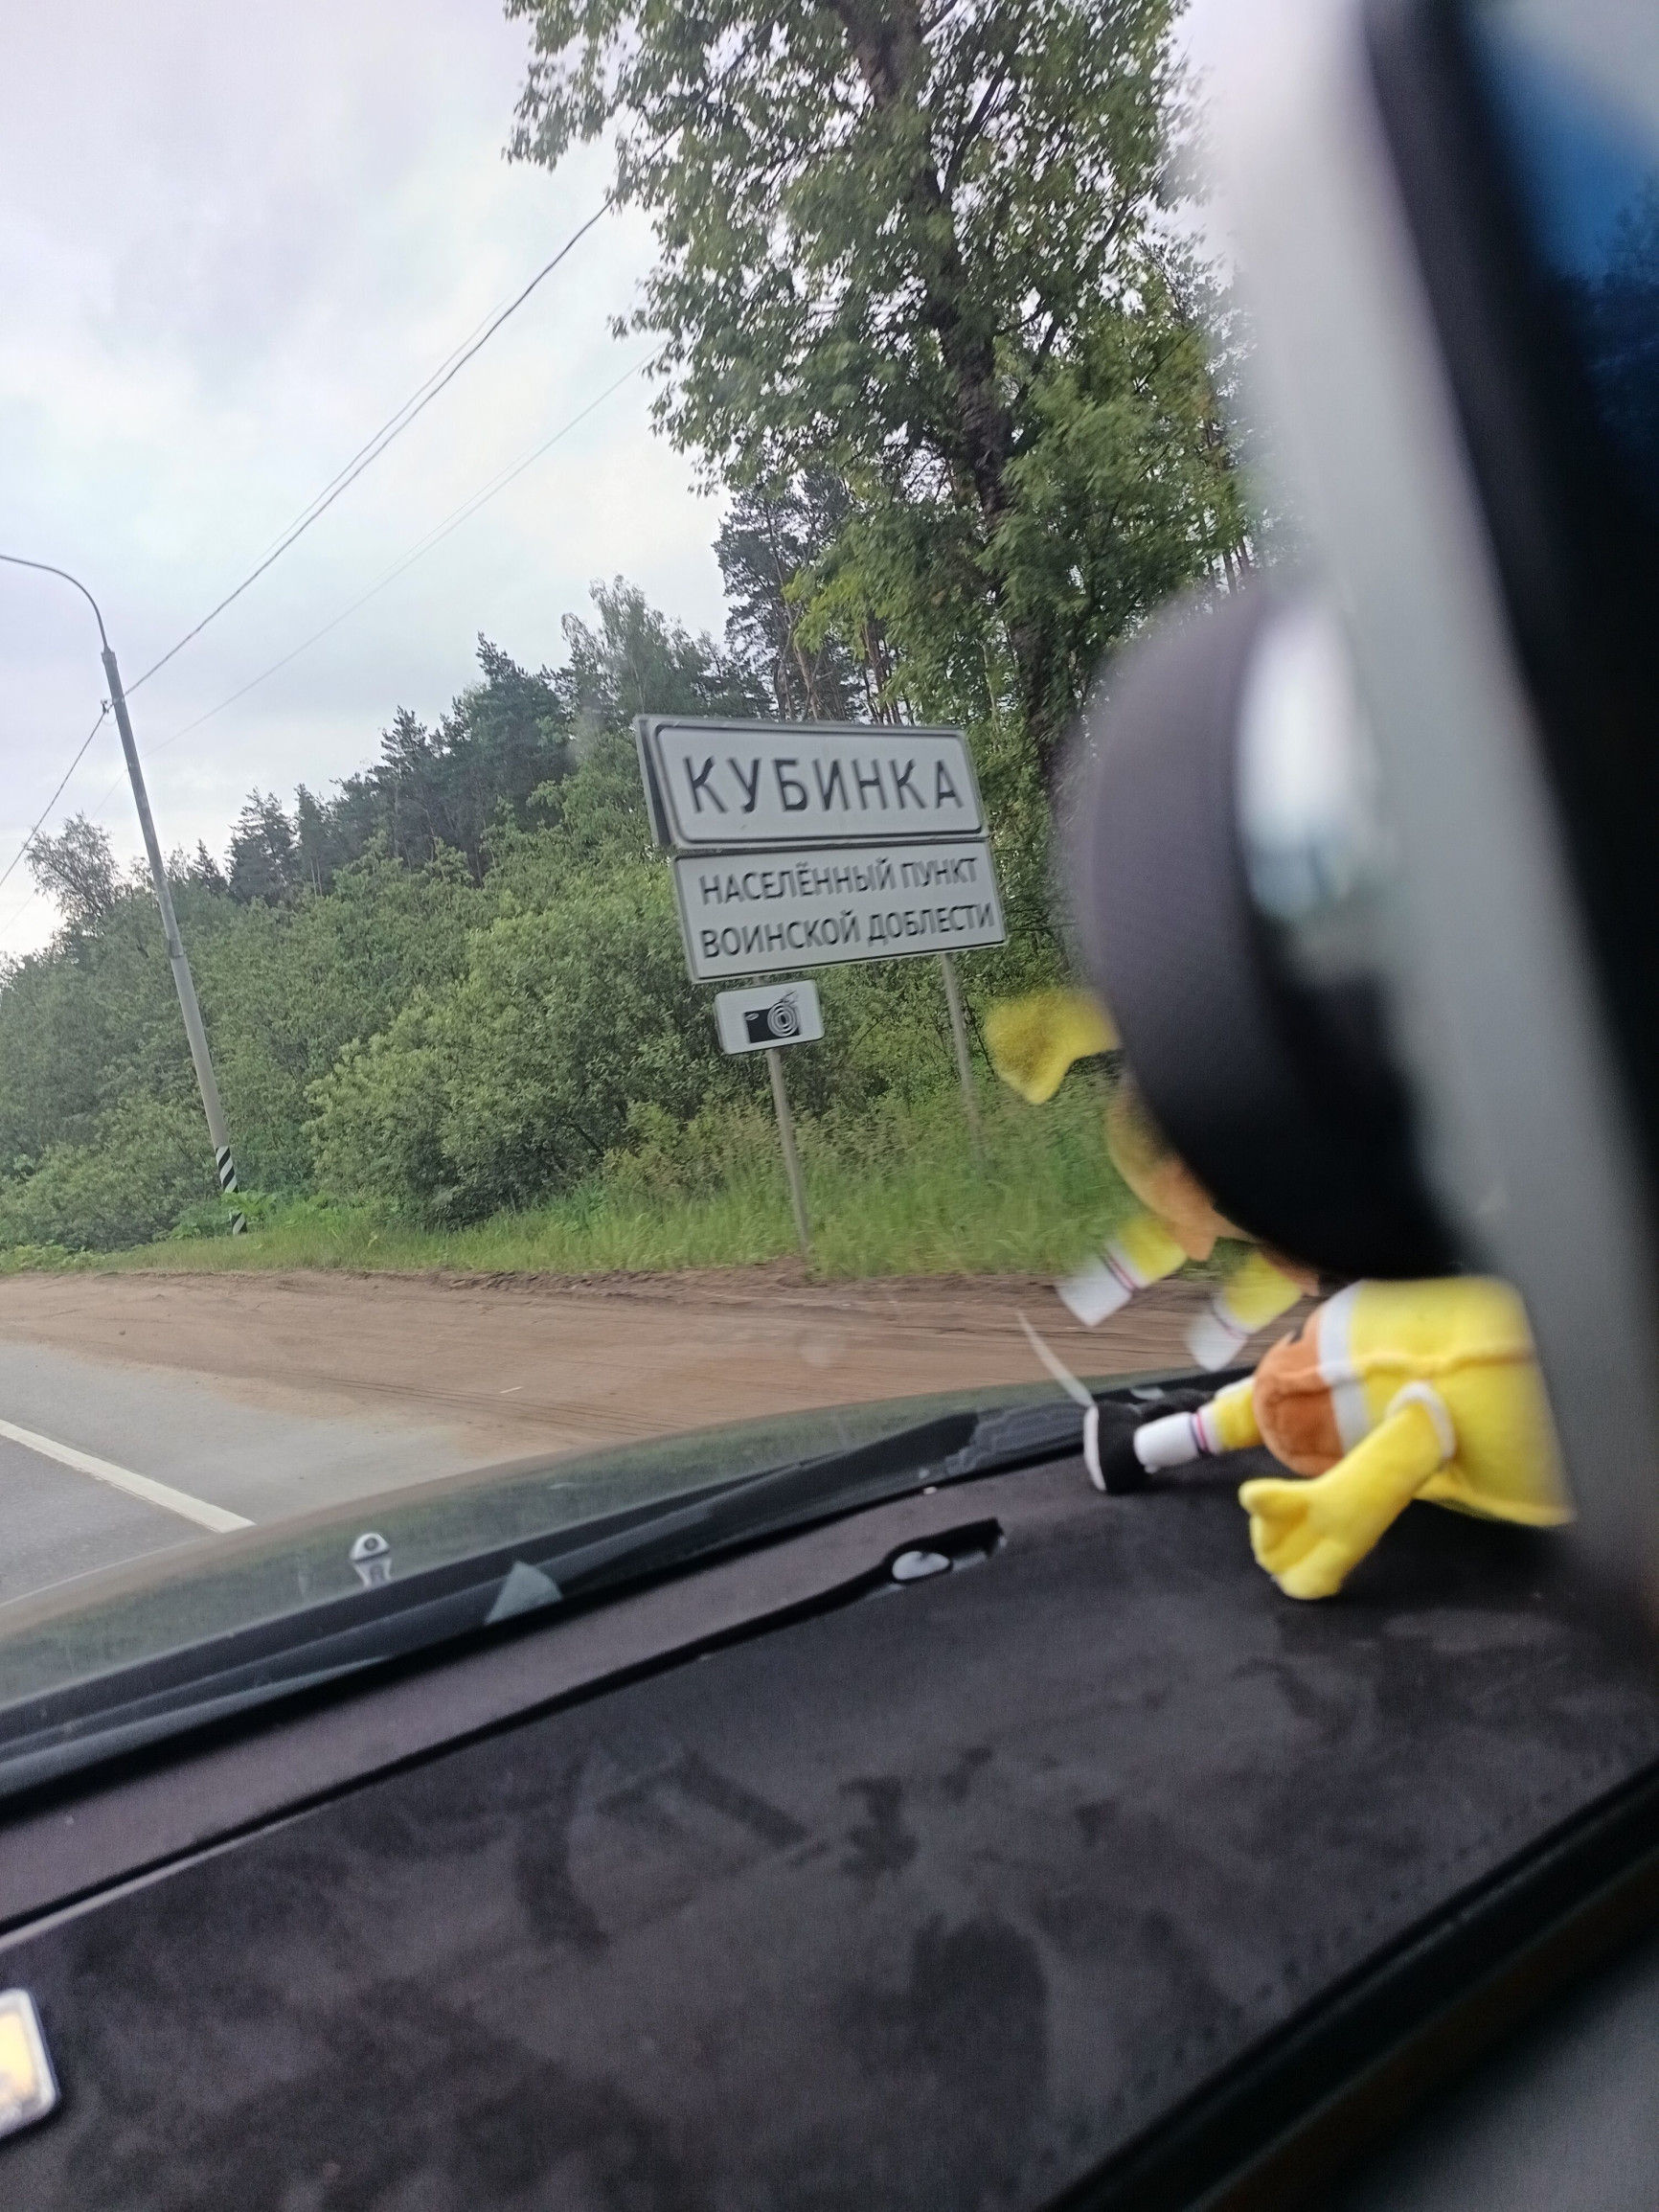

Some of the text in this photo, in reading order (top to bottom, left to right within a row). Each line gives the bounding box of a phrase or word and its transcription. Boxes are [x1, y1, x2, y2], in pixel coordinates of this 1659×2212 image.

[683, 755, 965, 814] КУБИНКА
[698, 857, 979, 905] НАСЕЛЁННЫЙ ПУНКТ
[699, 902, 995, 959] ВОИНСКОЙ ДОБЛЕСТИ
